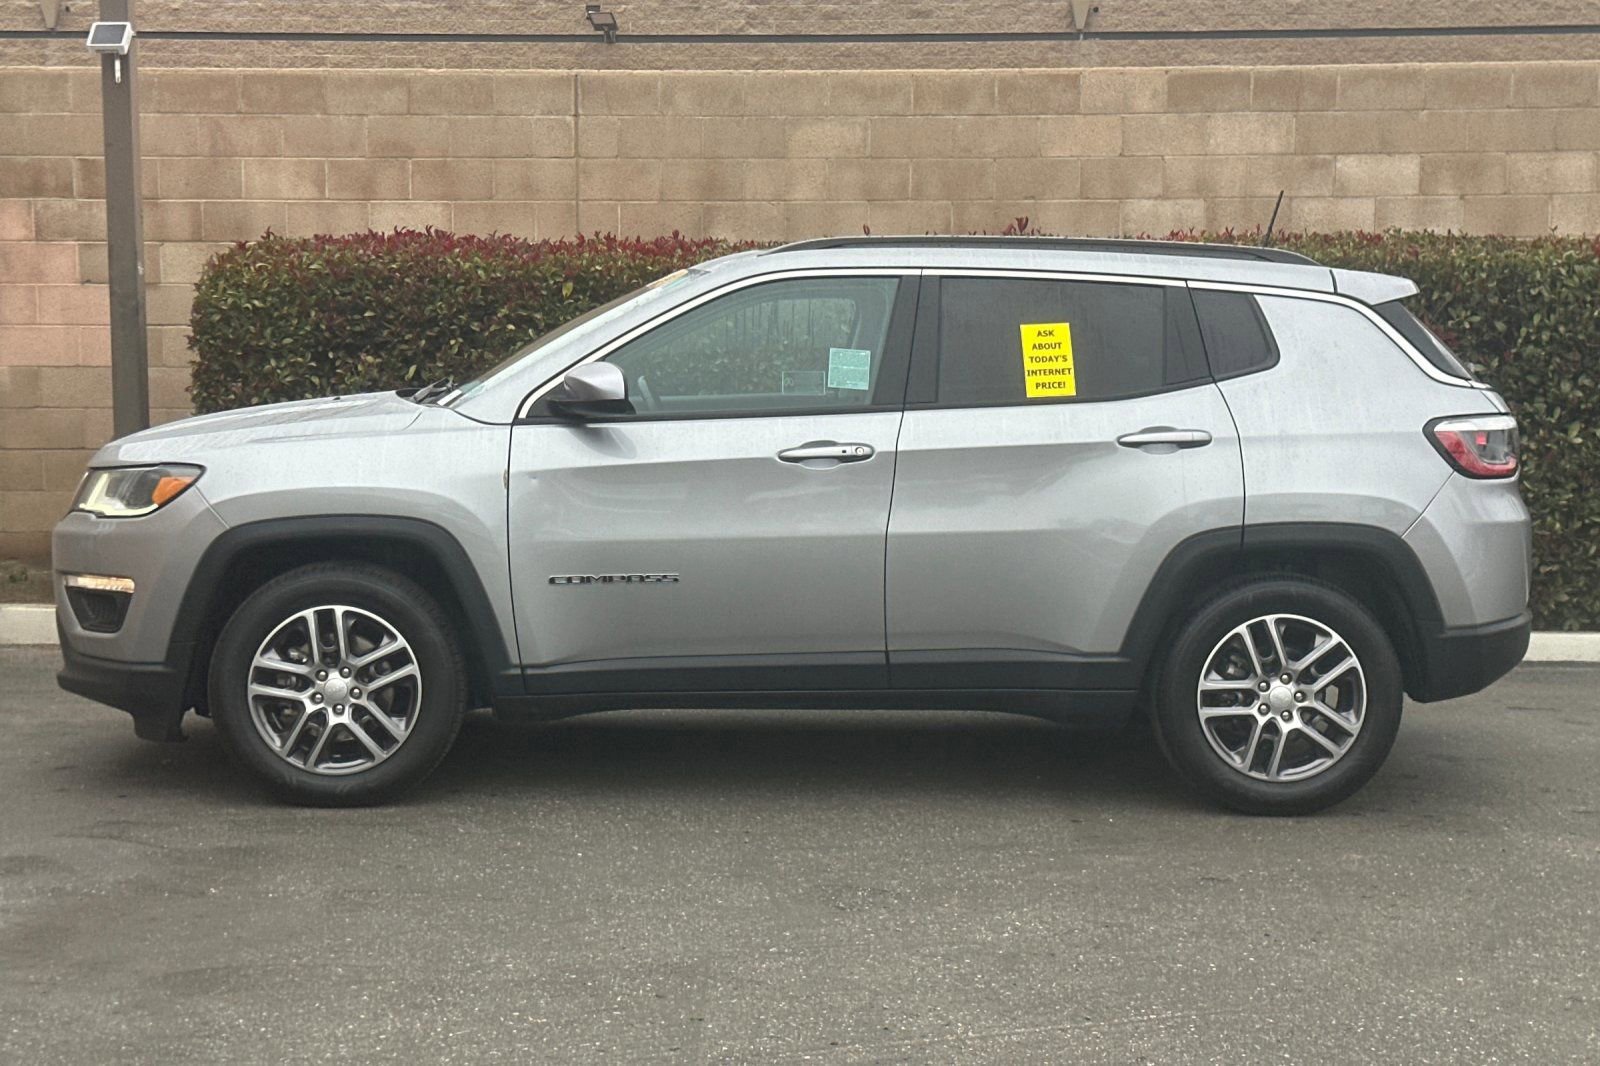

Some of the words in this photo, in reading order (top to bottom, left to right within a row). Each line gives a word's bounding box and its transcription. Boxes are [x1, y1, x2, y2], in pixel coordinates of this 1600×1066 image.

[1036, 329, 1055, 338] ASK
[1032, 342, 1062, 351] ABOUT
[1028, 355, 1068, 363] TODAY'S
[1026, 367, 1072, 377] INTERNET
[1035, 381, 1066, 390] PRICE!
[548, 573, 680, 584] COMPASS
